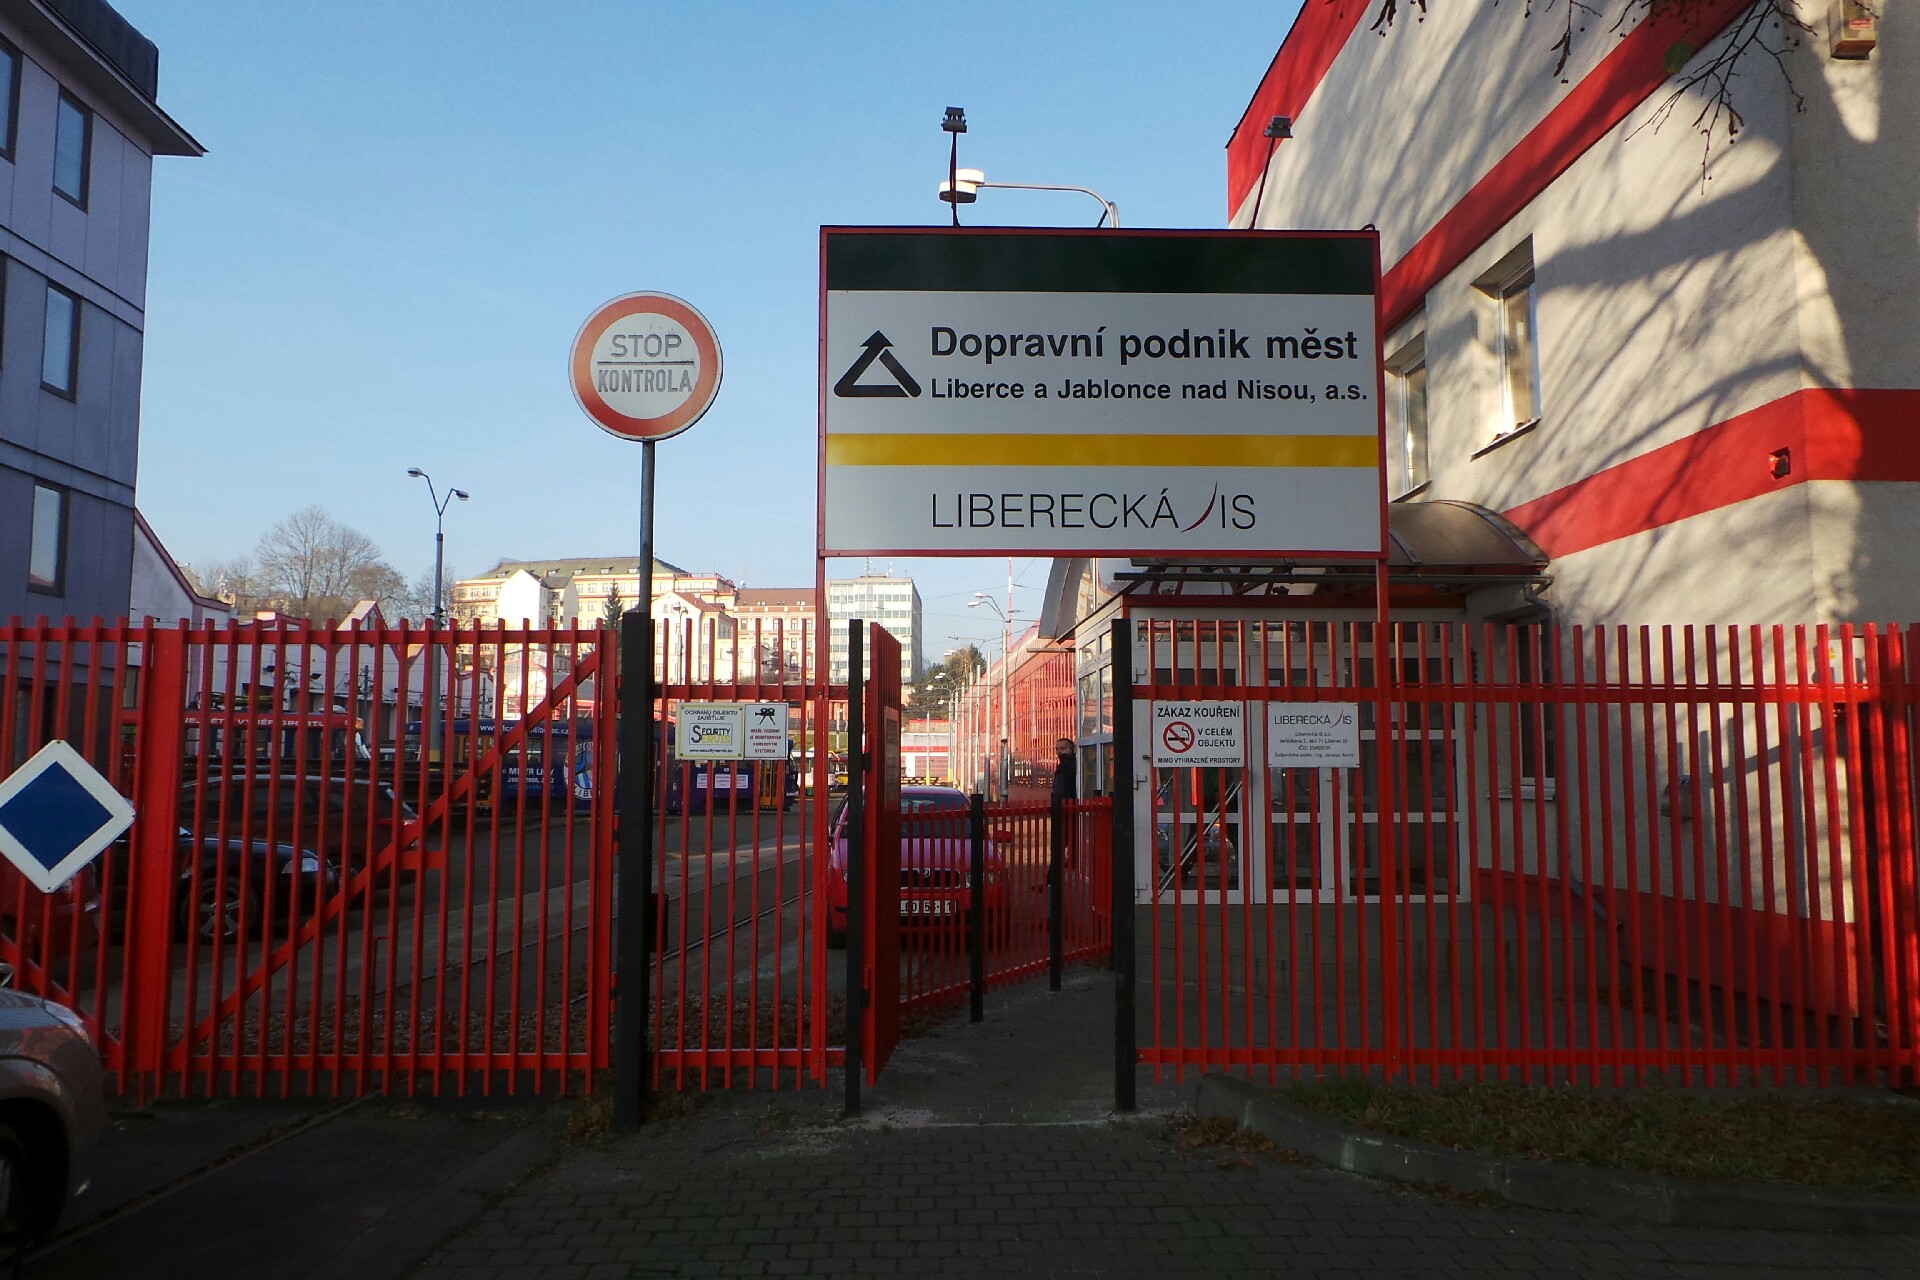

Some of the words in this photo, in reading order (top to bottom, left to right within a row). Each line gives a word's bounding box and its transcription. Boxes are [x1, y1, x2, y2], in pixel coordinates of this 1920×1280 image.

[611, 334, 682, 358] STOP
[931, 326, 1107, 364] Dopravní
[1120, 328, 1250, 365] podnik
[1266, 328, 1358, 359] měst
[598, 369, 692, 393] KONTROLA
[931, 378, 1024, 399] Liberce
[1034, 383, 1048, 399] a
[1057, 379, 1171, 399] Jablonce
[1182, 380, 1227, 399] nad
[1237, 380, 1316, 403] Nisou,
[1325, 384, 1367, 400] a.s.
[932, 488, 1179, 528] LIBERECKÁ
[1220, 494, 1256, 529] IS
[1157, 705, 1191, 718] ZÁKAZ
[1194, 705, 1240, 718] KOUŘENÍ
[1274, 714, 1331, 725] LIBERECKÁ
[1197, 728, 1203, 736] V
[1205, 726, 1233, 736] CELÉM
[1197, 739, 1236, 747] OBJEKTU
[1174, 756, 1208, 764] VYHRAZENÉ
